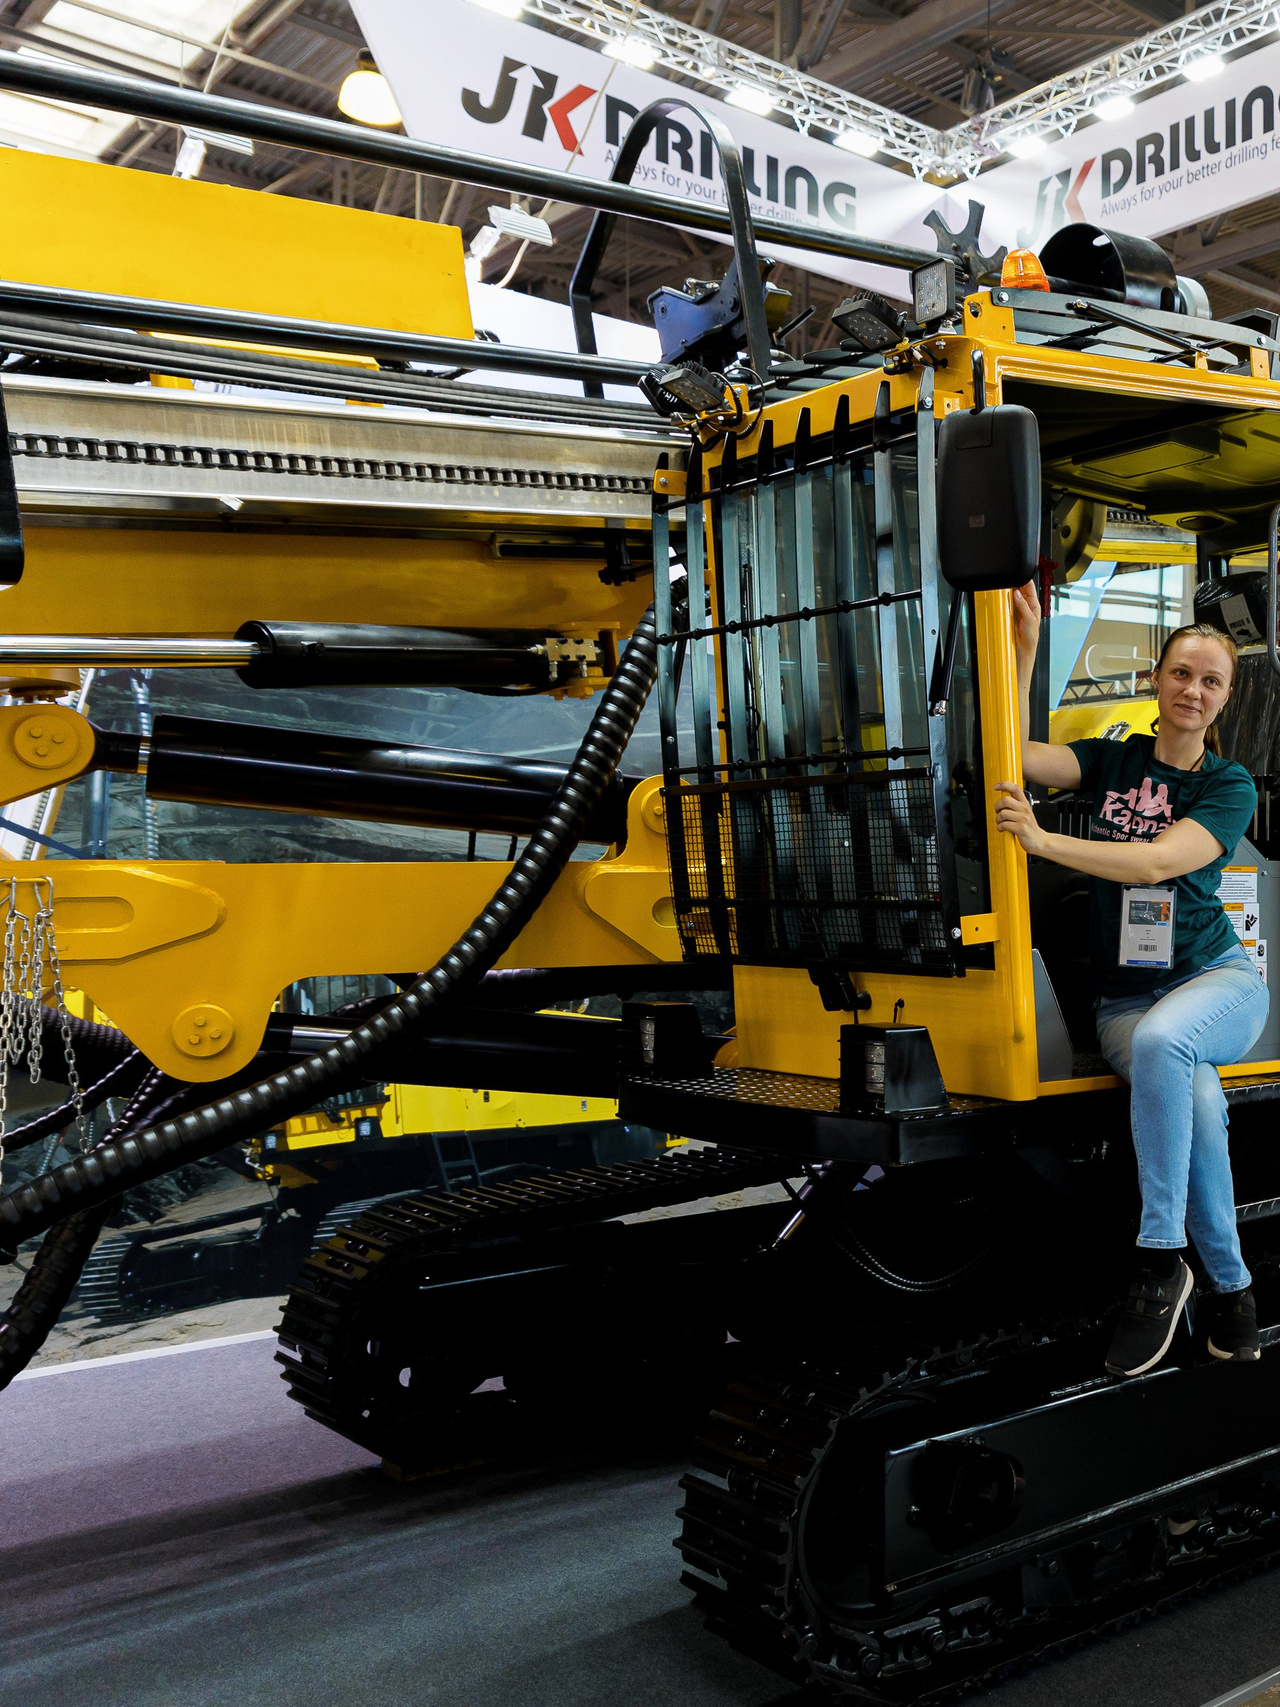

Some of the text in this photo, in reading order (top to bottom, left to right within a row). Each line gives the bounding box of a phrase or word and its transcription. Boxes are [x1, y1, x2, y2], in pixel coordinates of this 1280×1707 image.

[661, 167, 681, 188] for
[685, 180, 717, 200] your
[1100, 194, 1137, 218] Always
[1140, 185, 1155, 202] for
[1158, 175, 1183, 199] your
[1187, 160, 1222, 184] better
[1225, 142, 1268, 169] drilling
